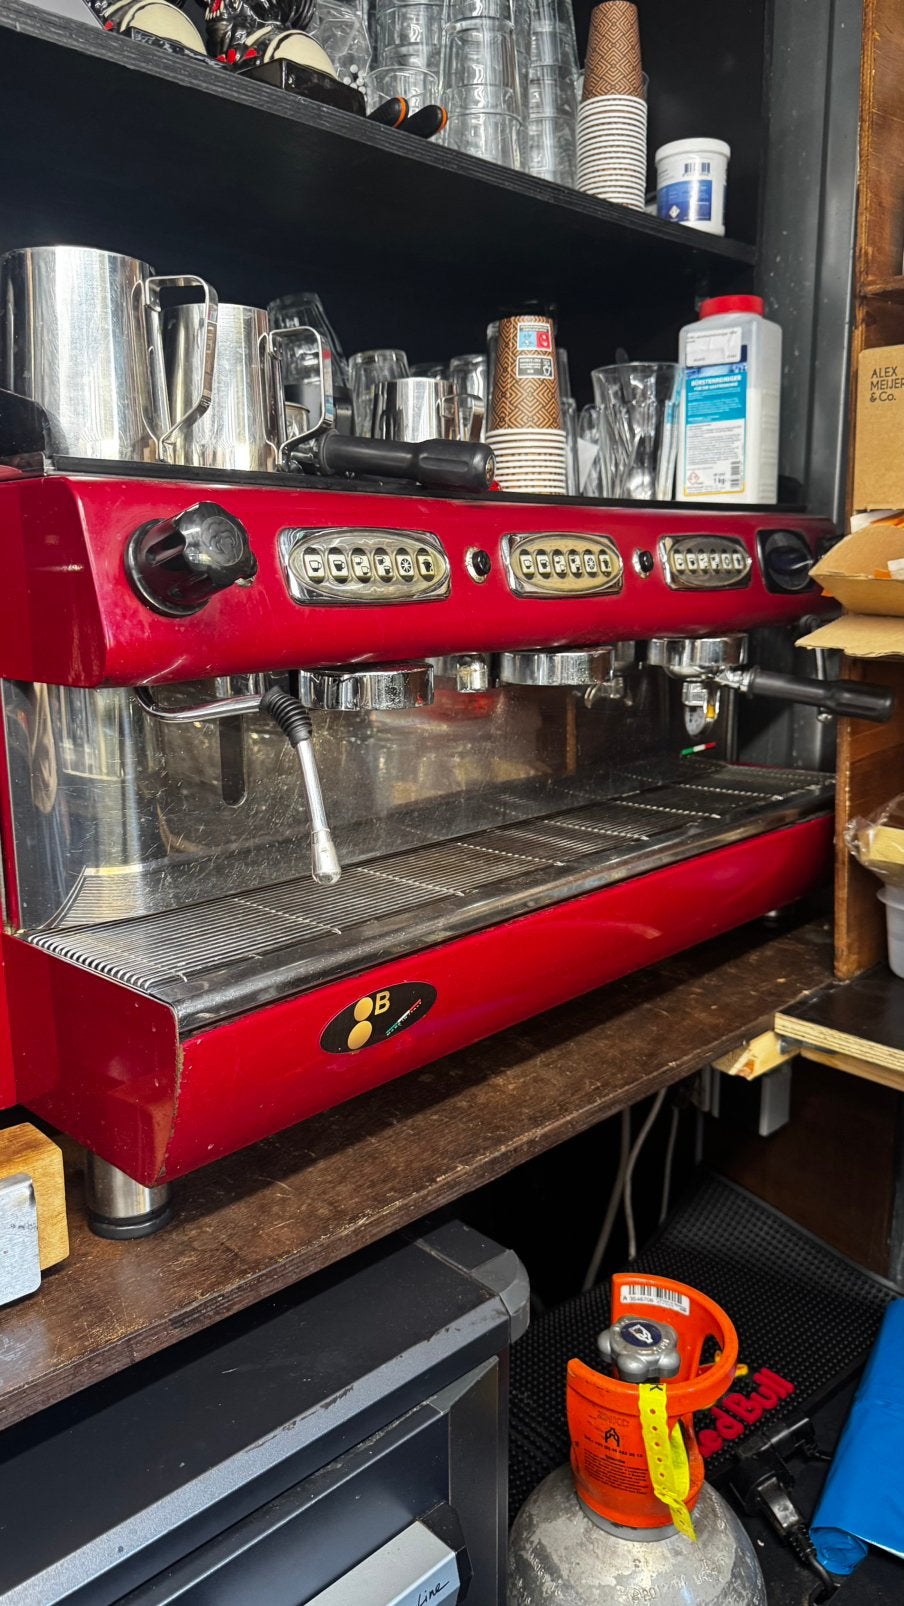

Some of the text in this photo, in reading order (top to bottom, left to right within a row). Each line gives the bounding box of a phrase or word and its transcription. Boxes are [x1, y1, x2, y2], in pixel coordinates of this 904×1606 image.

[870, 366, 898, 379] ALEX
[870, 378, 904, 391] MEIJER
[870, 391, 896, 403] & Co.
[375, 990, 390, 1015] B
[722, 1367, 795, 1425] Bull
